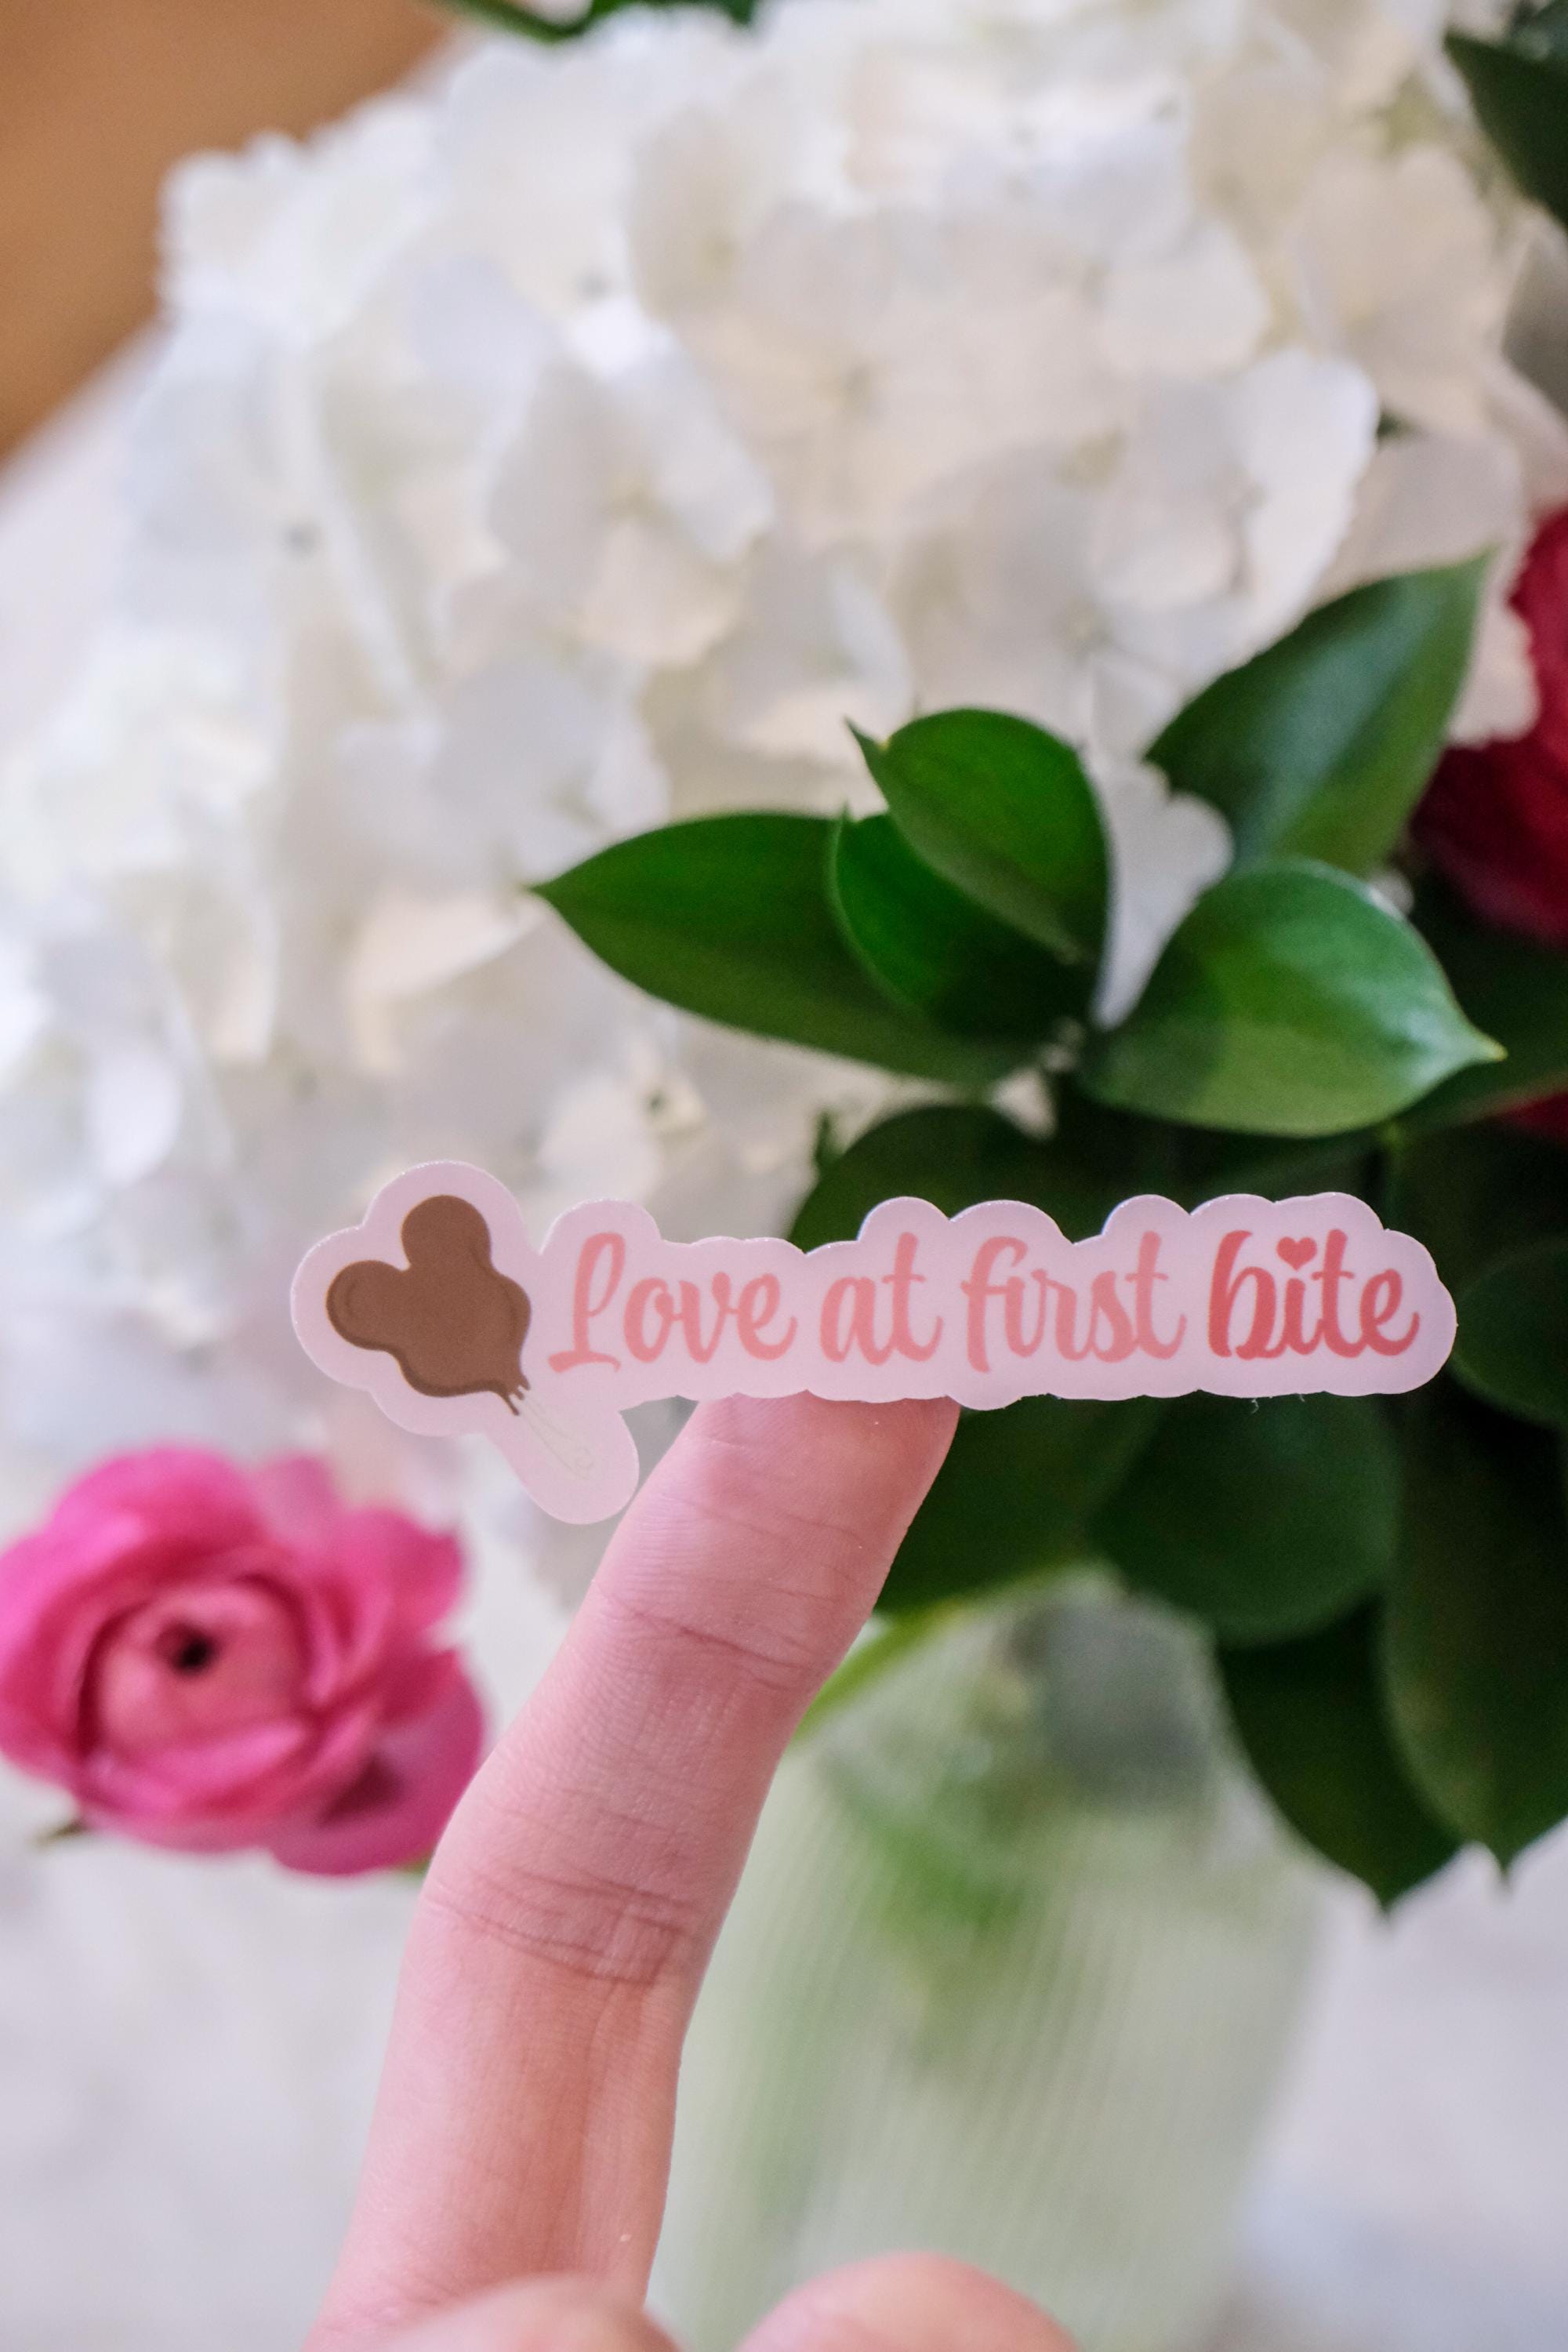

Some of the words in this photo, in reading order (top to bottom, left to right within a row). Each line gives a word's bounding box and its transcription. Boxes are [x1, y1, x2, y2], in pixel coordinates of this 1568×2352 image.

[548, 1232, 798, 1374] Love
[818, 1232, 944, 1367] at
[960, 1231, 1186, 1374] first
[1207, 1229, 1421, 1361] bite
